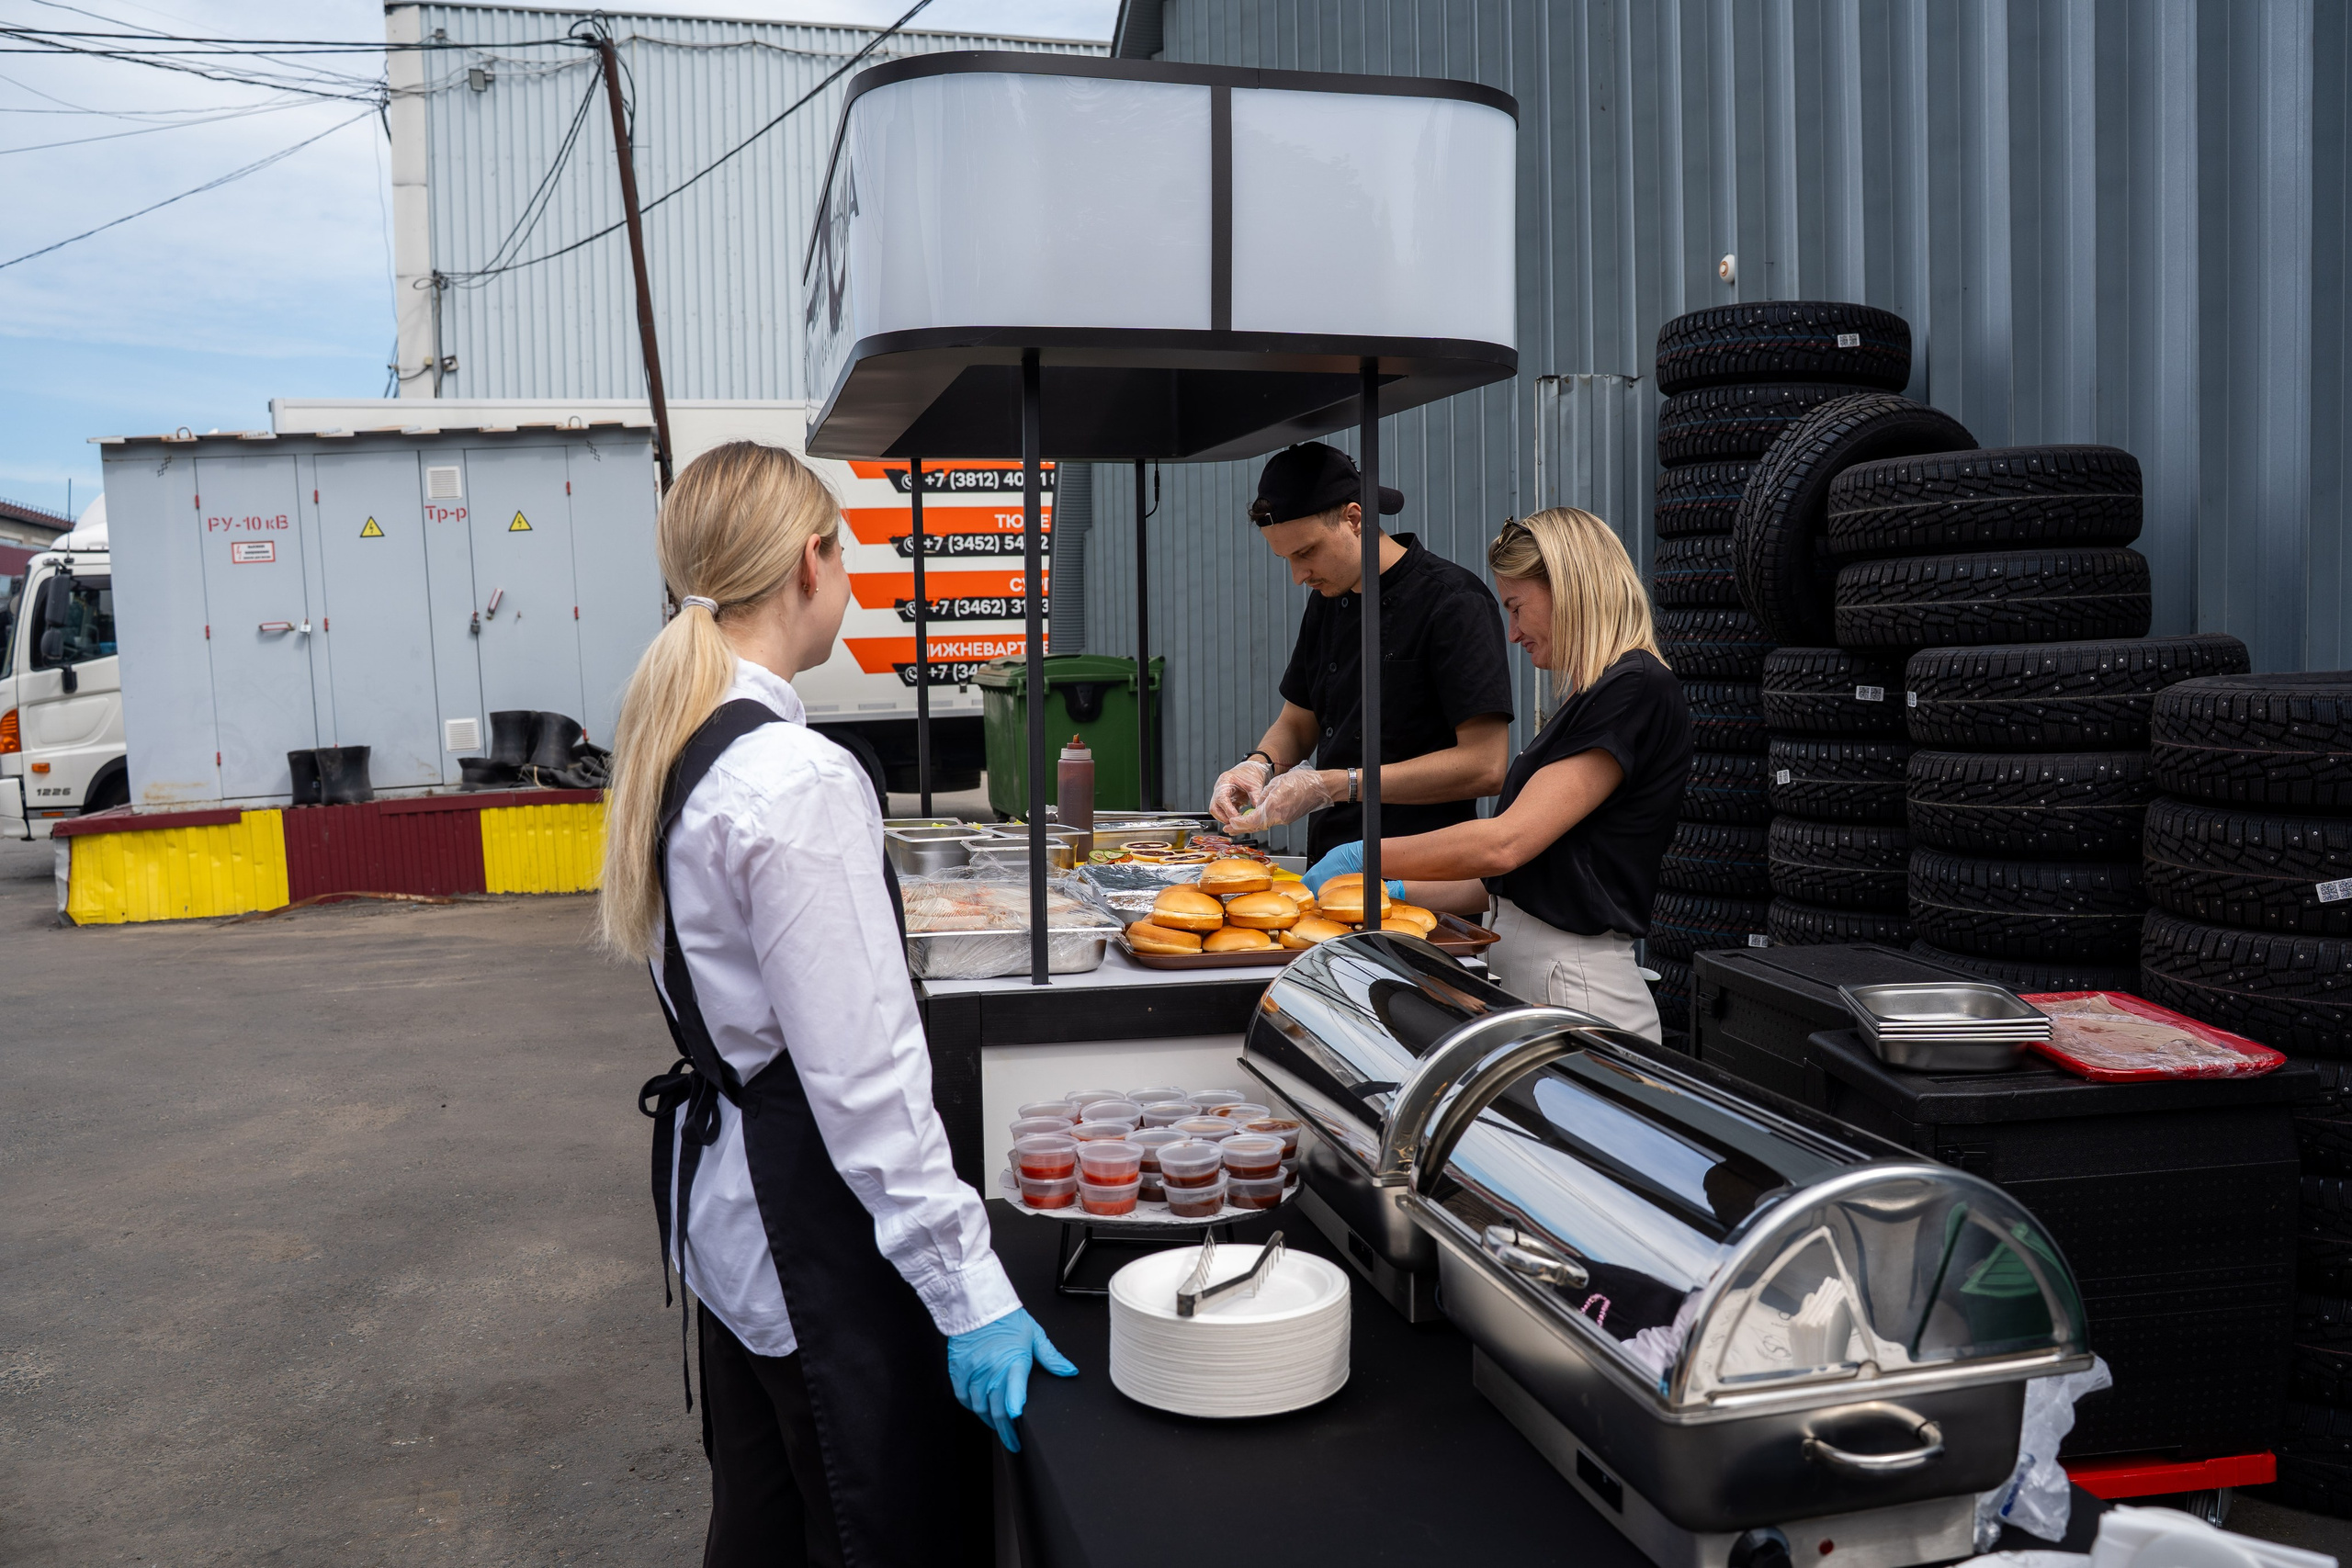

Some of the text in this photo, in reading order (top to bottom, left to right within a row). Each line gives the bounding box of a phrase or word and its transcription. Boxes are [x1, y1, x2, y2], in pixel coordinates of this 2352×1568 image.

[924, 472, 944, 488] +7
[950, 471, 1000, 490] (3812)
[1003, 471, 1024, 487] 40
[208, 514, 288, 532] РУ-10 кВ
[424, 505, 467, 524] Тр-р
[994, 513, 1052, 529] ТЮЕ
[923, 536, 944, 551] +7
[948, 535, 1001, 553] (3452)
[1003, 535, 1024, 550] 54
[930, 600, 950, 615] +7
[954, 598, 1007, 617] (3462)
[928, 663, 987, 682] +7 (34
[37, 787, 72, 796] 1226
